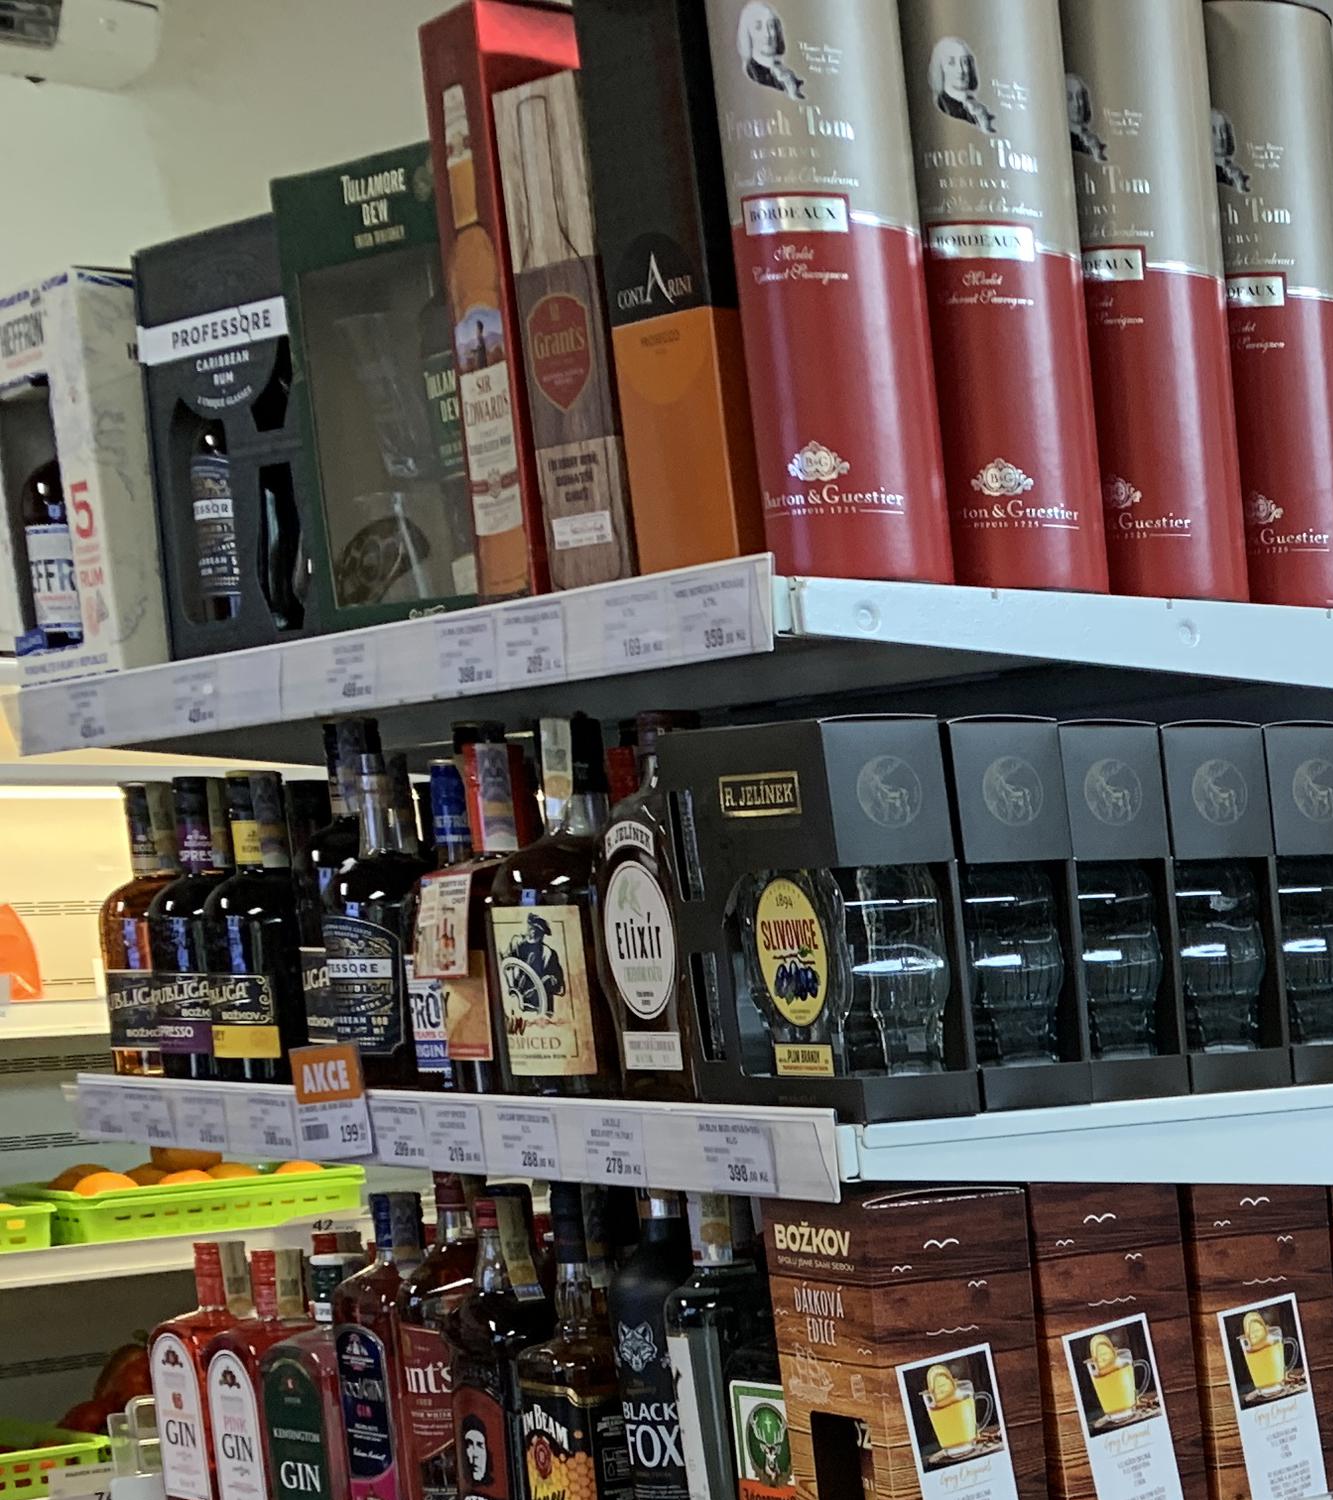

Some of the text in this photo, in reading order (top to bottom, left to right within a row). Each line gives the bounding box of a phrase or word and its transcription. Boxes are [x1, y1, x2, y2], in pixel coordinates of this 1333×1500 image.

[803, 104, 855, 142] Tom
[923, 138, 1040, 174] rench Tom
[340, 168, 406, 206] TULLAMORE
[1102, 166, 1151, 197] Tom
[361, 200, 388, 226] DEW
[749, 204, 837, 224] BORDEAUX
[934, 232, 1024, 252] BORDEAUX
[172, 309, 272, 349] PROFESSORE
[533, 323, 585, 359] Grant's
[212, 371, 234, 386] RUM
[70, 481, 95, 539] 5
[822, 484, 905, 507] Guestier
[1119, 512, 1192, 532] Guestier
[1260, 528, 1330, 548] Guestier
[737, 777, 796, 810] JELÍNEK
[761, 917, 820, 953] SLIVOVICE
[302, 1059, 350, 1095] AKCE
[774, 1221, 850, 1257] BOŽKOV
[794, 1281, 844, 1318] DÁRKOVÁ
[806, 1317, 837, 1346] EDICE
[533, 1404, 568, 1451] BEAM
[622, 1401, 678, 1422] BLACK
[165, 1418, 197, 1448] GIN
[222, 1433, 253, 1463] GIN
[627, 1423, 686, 1468] FOX
[280, 1460, 322, 1493] GIN
